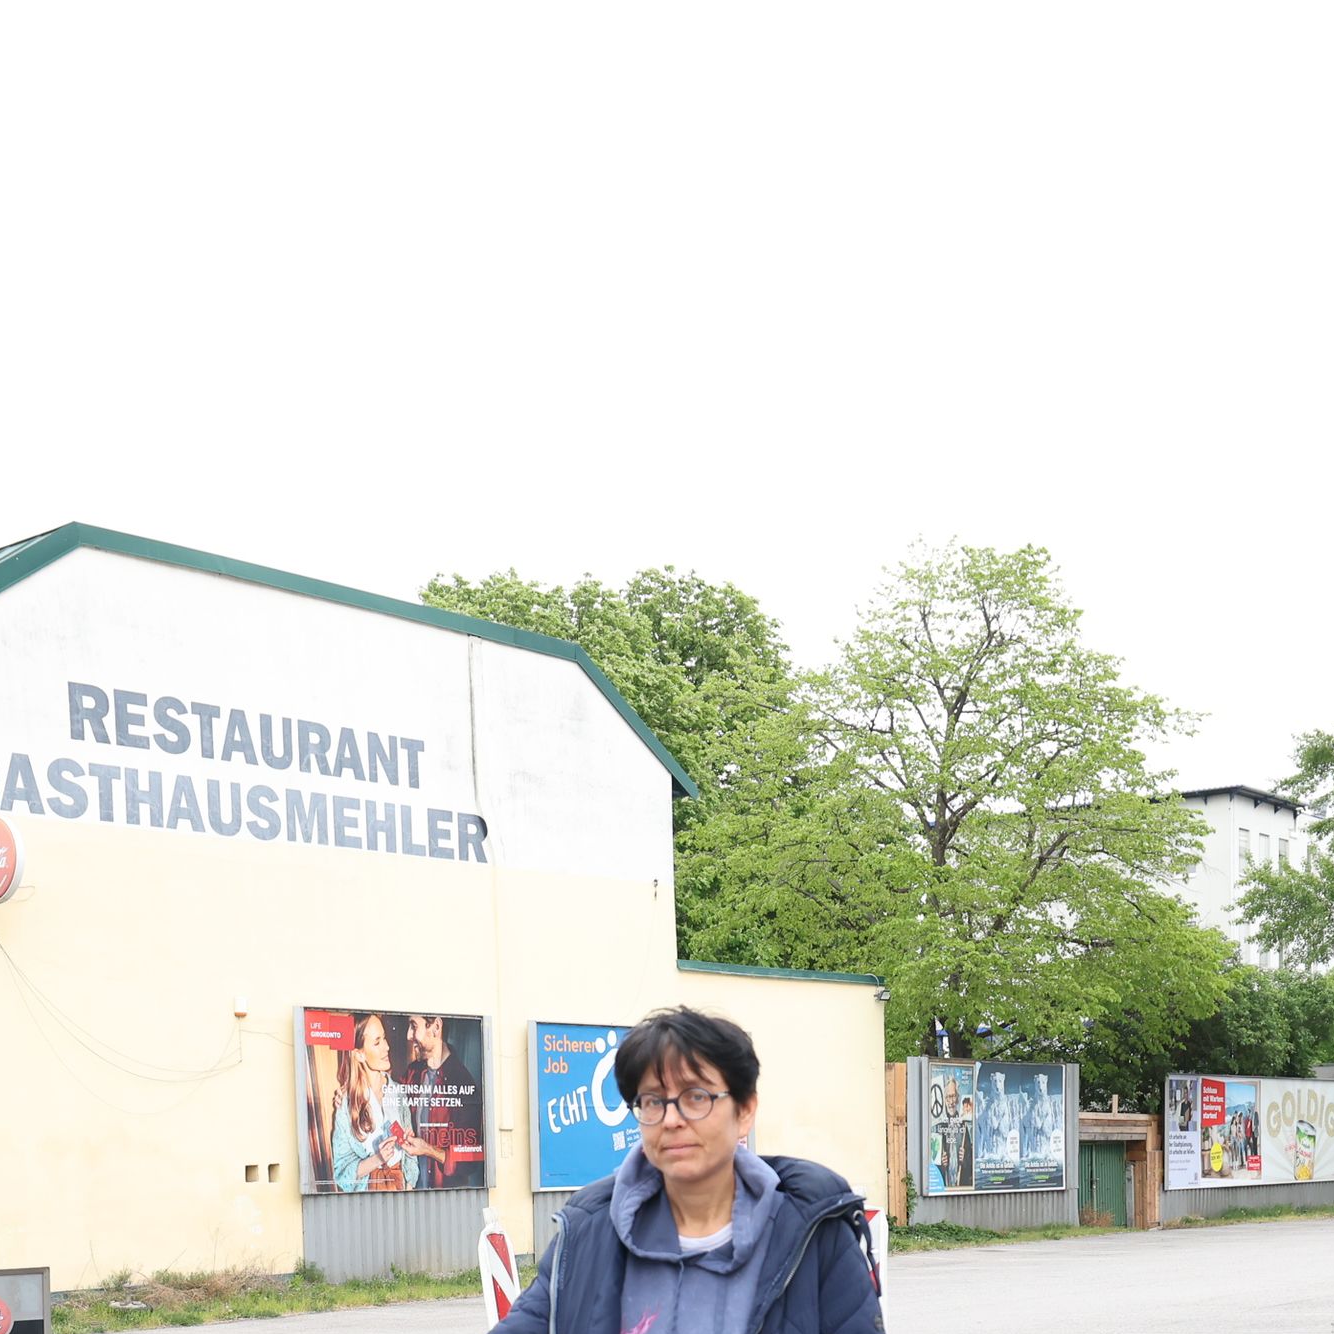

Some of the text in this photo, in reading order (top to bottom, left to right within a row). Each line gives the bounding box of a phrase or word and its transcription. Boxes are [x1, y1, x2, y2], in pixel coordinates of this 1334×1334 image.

[67, 681, 425, 789] RESTAURANT
[310, 1022, 322, 1030] LIFE
[310, 1031, 342, 1039] GIROKONTO
[543, 1056, 569, 1074] Job
[381, 1084, 476, 1096] GEMEINSAM ALLES AUF
[382, 1097, 464, 1107] EINE KARTE SETZEN.
[547, 1085, 588, 1134] ECHT
